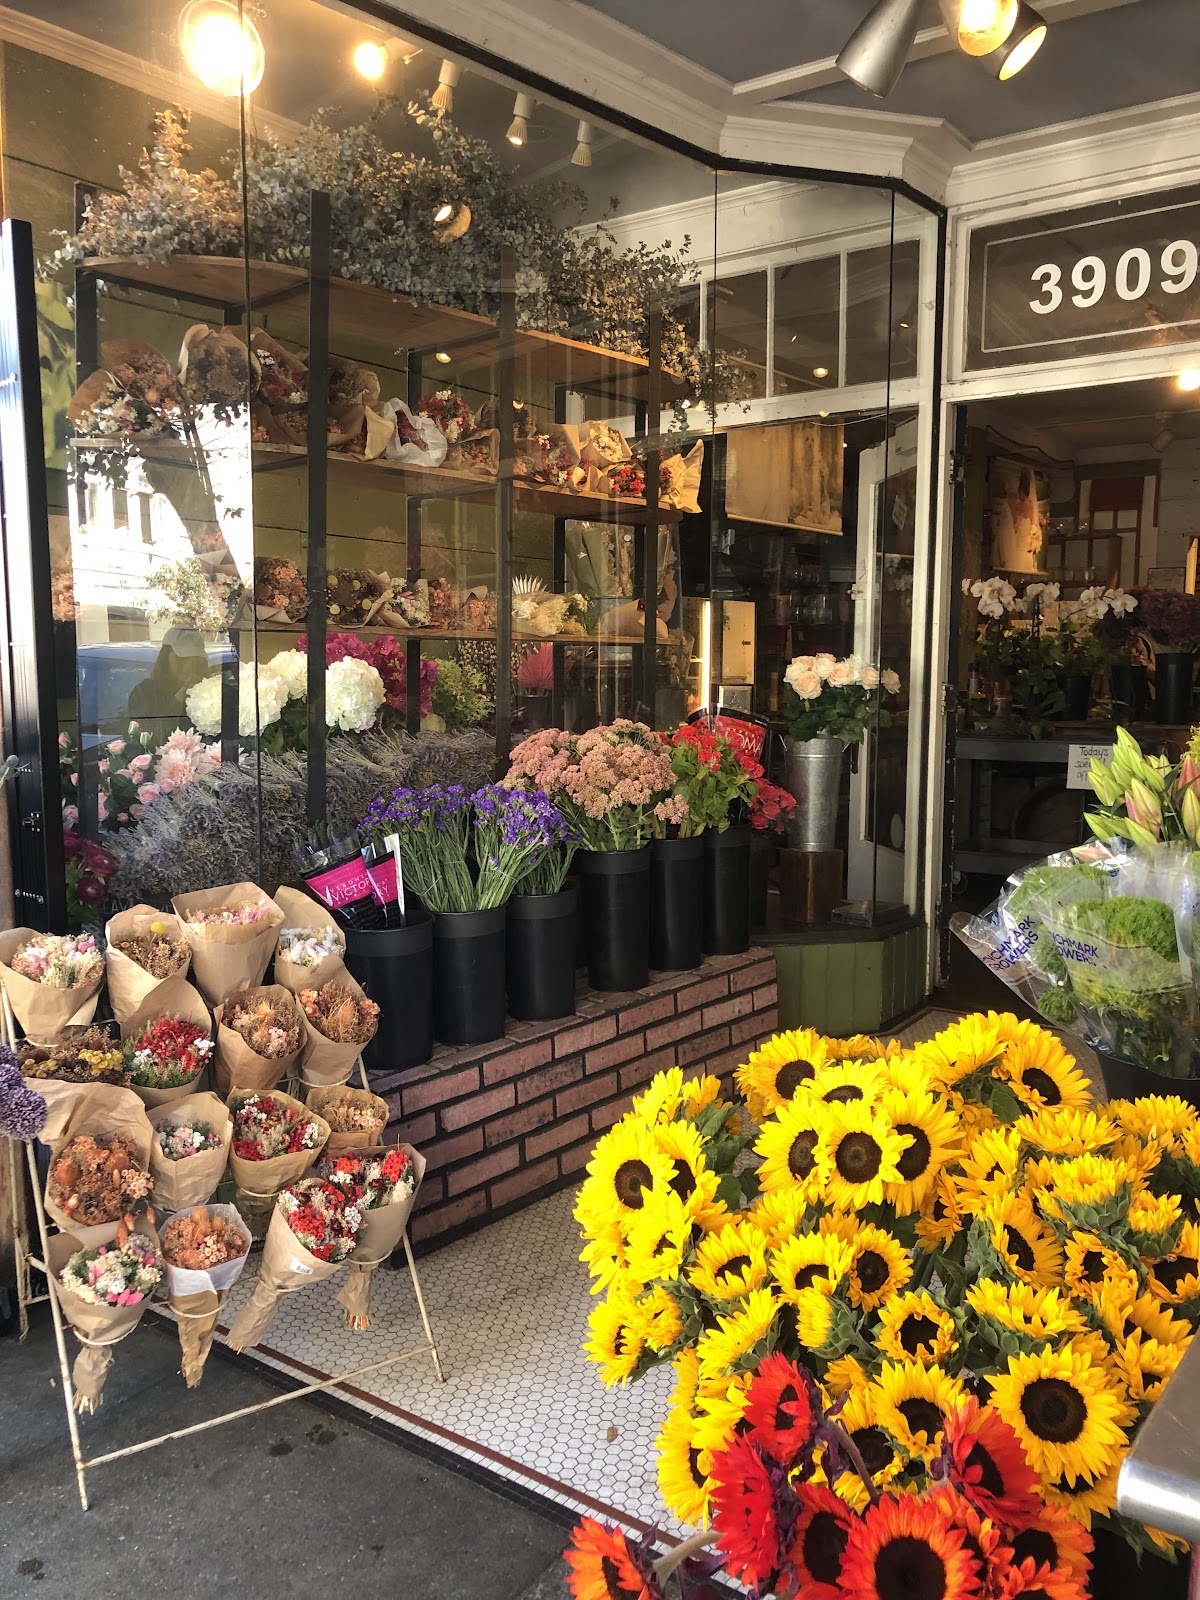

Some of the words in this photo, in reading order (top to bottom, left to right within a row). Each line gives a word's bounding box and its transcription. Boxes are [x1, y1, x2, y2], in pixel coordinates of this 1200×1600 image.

[1029, 239, 1198, 315] 3909
[1079, 746, 1109, 760] Today's
[331, 877, 370, 901] VICTOR
[983, 915, 1035, 963] NCHMARK
